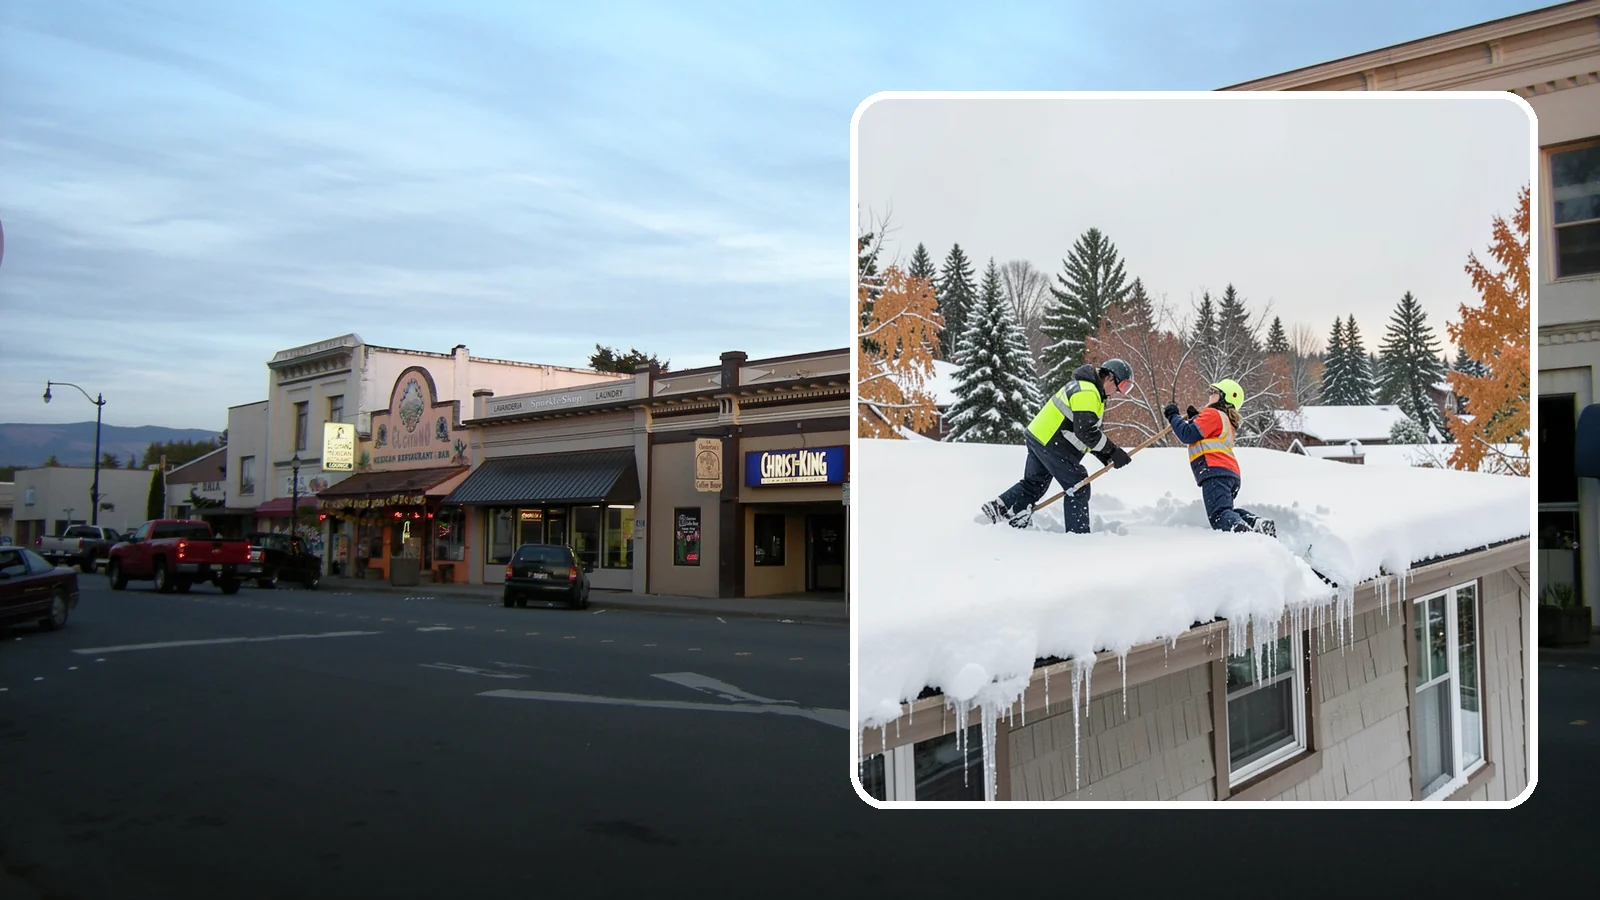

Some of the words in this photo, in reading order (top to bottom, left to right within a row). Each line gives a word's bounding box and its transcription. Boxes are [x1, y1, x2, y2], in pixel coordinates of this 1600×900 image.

[595, 388, 624, 400] LAUNDRY
[493, 402, 523, 413] LAVANDERIA
[530, 397, 561, 409] Sparkle
[561, 394, 583, 404] Shop
[373, 455, 396, 464] MEXICAN
[397, 451, 433, 462] RESTAURANT
[438, 450, 450, 459] BAR
[799, 450, 828, 476] KING
